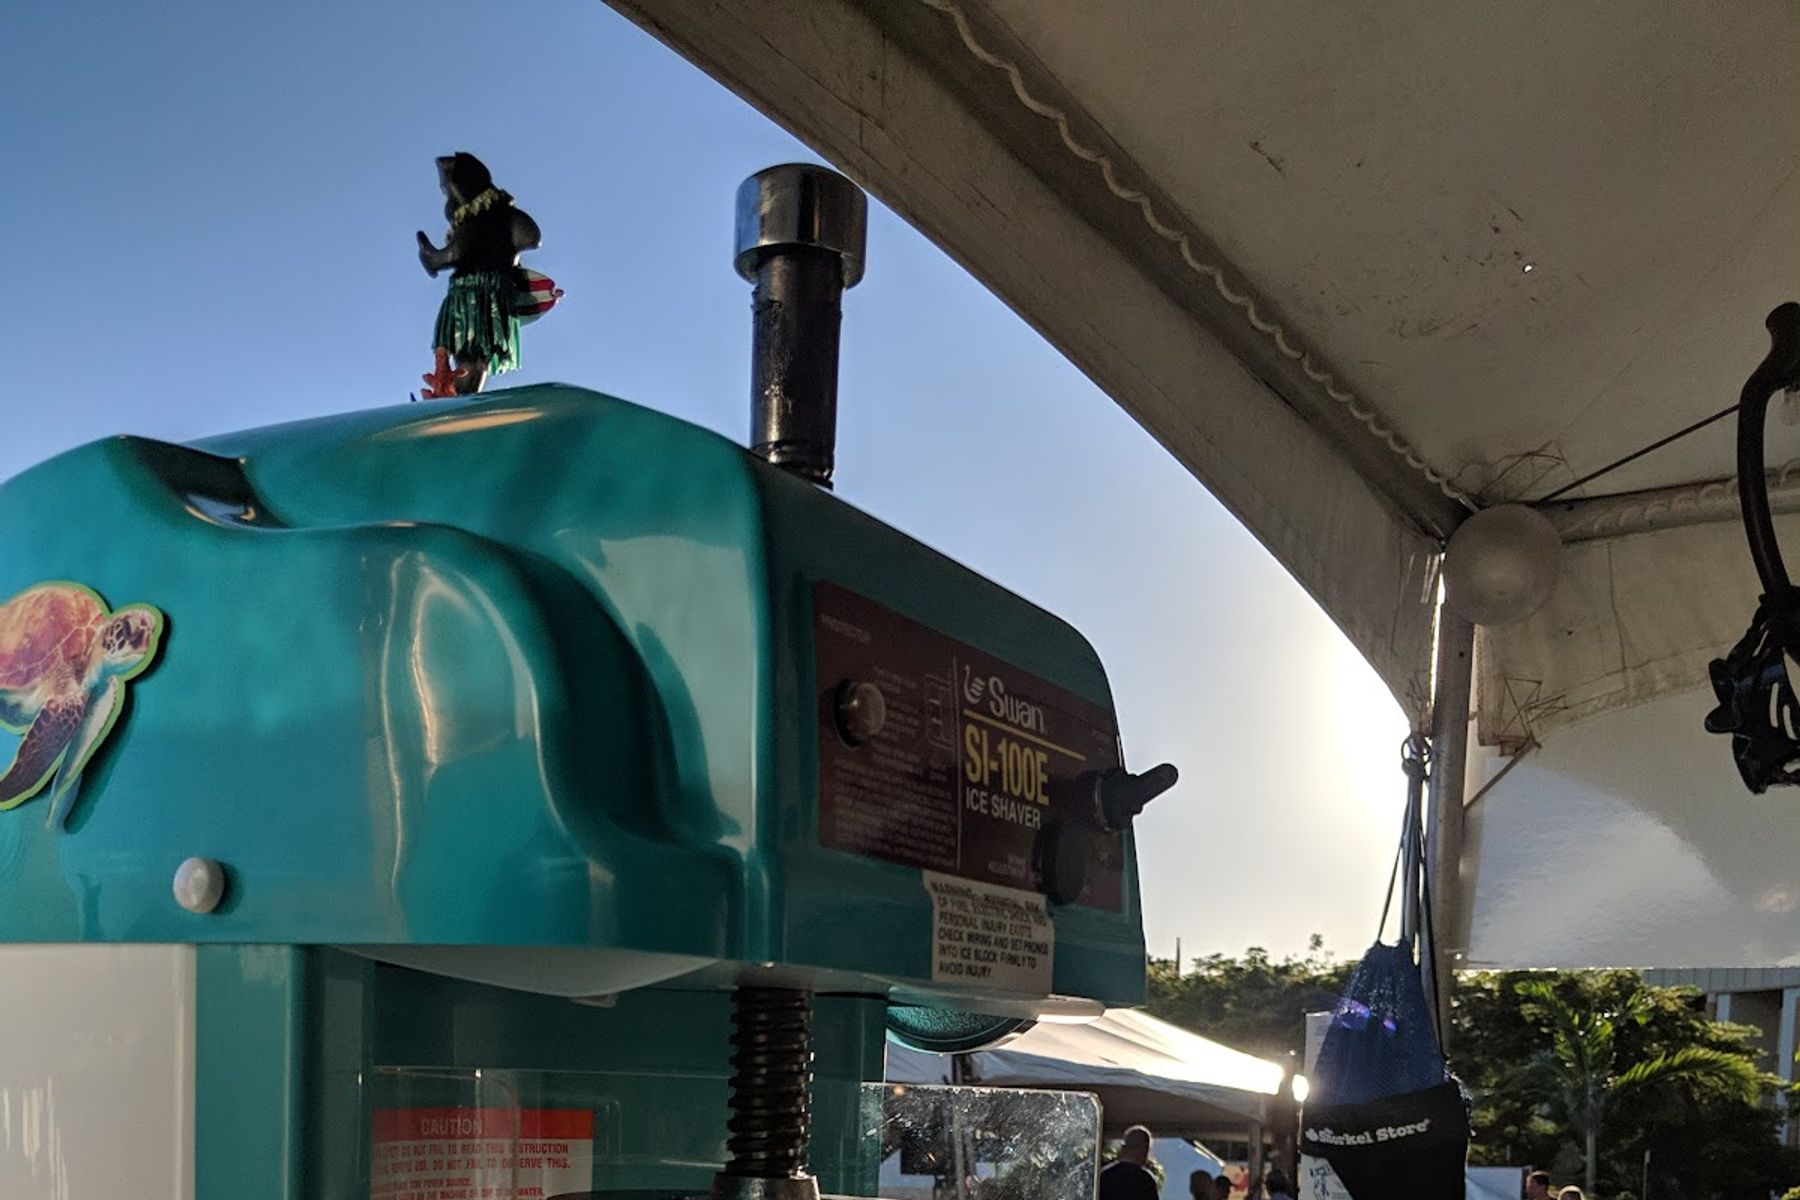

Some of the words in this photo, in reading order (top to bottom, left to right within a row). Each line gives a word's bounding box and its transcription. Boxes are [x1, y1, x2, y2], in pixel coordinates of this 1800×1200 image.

[987, 675, 1044, 735] Swan
[964, 722, 1049, 806] SI-100E
[965, 786, 988, 815] ICE
[990, 793, 1041, 831] SHAVER
[938, 911, 980, 930] PERSONAL
[981, 919, 1007, 933] INJURY
[938, 926, 964, 942] CHECK
[966, 931, 993, 948] WIRING
[993, 936, 1008, 950] AND
[1010, 938, 1022, 951] SET
[1023, 940, 1048, 955] PRONGS
[938, 943, 958, 958] INTO
[959, 947, 972, 960] ICE
[973, 949, 997, 963] BLOCK
[938, 960, 963, 976] AVOID
[420, 1117, 483, 1136] CAUTION
[1375, 1121, 1429, 1143] Store
[447, 1143, 458, 1154] TO
[509, 1143, 569, 1154] ISTRUCTION
[447, 1159, 461, 1170] NOT
[487, 1159, 497, 1169] TO
[502, 1158, 542, 1169] OBERVE
